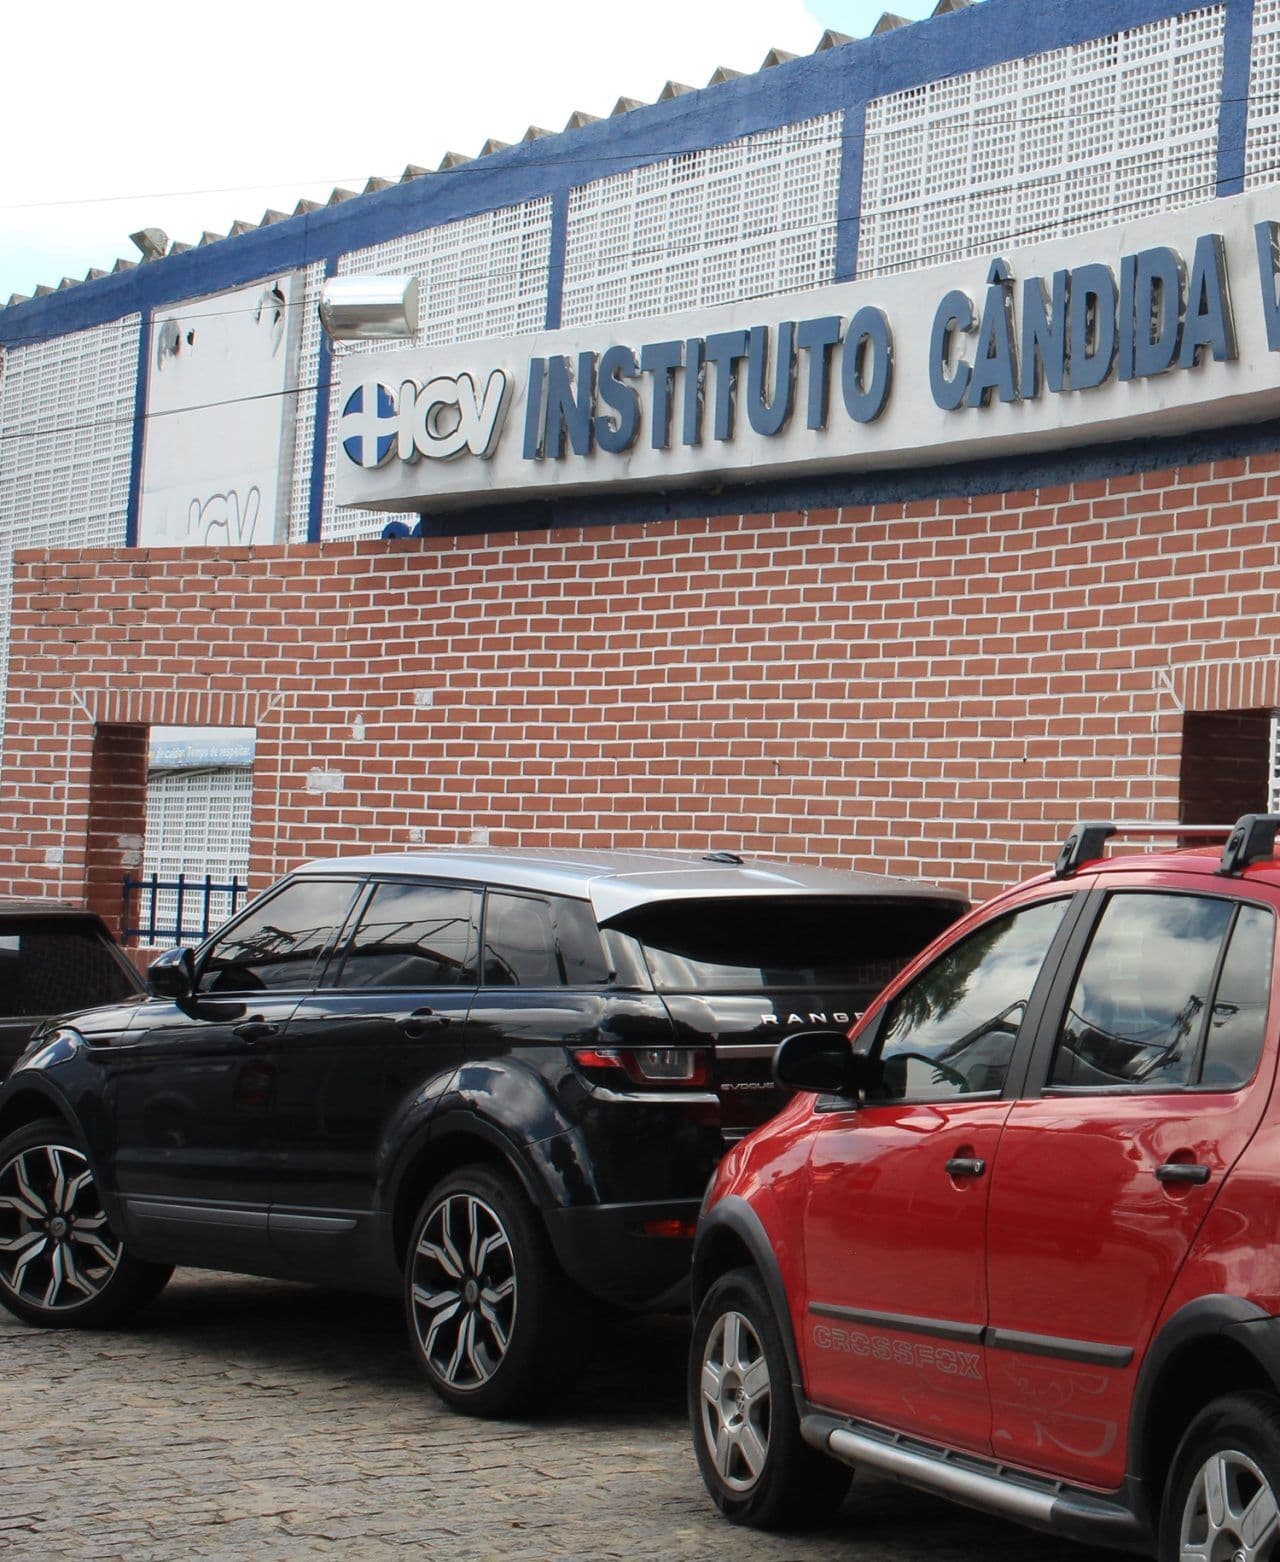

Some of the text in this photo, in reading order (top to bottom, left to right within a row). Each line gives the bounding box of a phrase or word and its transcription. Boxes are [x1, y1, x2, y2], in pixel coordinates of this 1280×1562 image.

[398, 368, 513, 464] ICV
[522, 305, 895, 461] INSTITUTO
[928, 232, 1239, 411] CÂNDIDA
[812, 1324, 984, 1381] CROSSFOX
